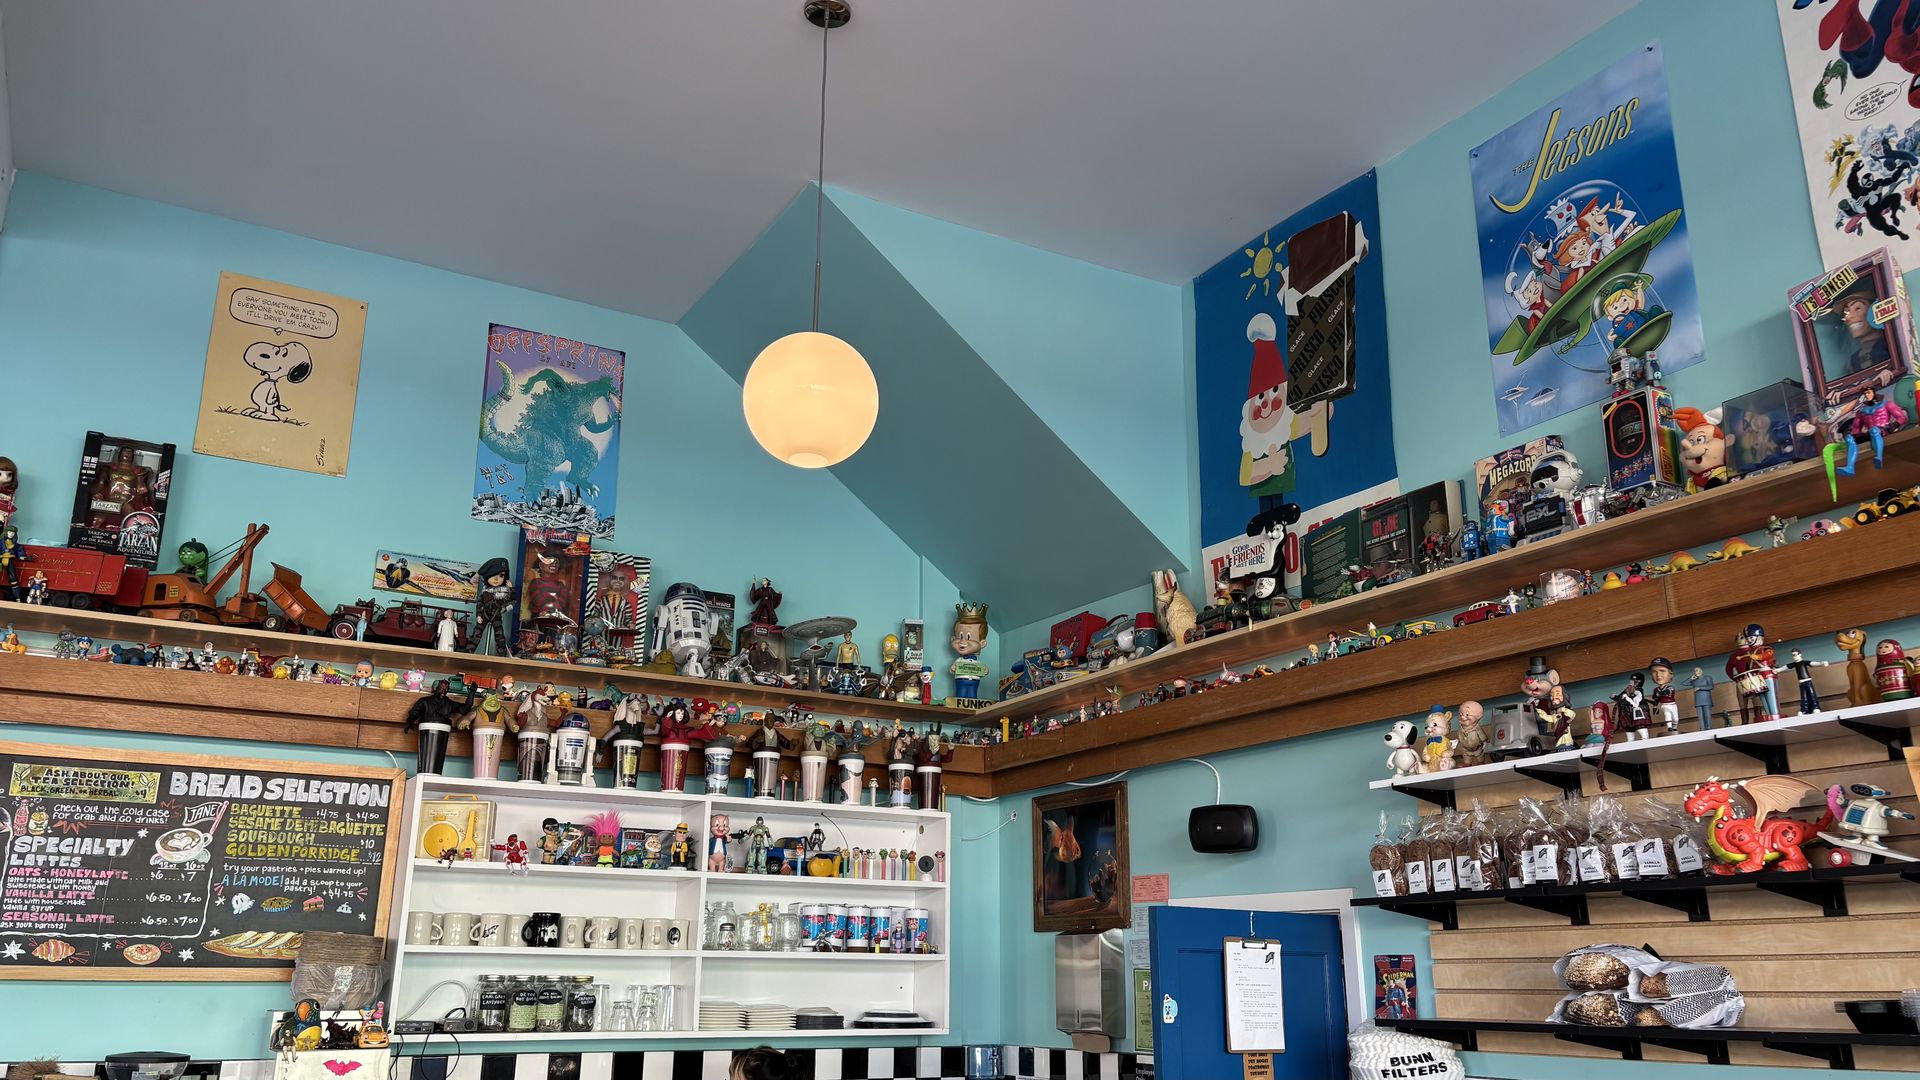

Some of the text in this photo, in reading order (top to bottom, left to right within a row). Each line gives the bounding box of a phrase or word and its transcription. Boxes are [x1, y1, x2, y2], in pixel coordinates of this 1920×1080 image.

[1489, 97, 1640, 214] THE Jetsons
[1811, 267, 1854, 307] ERNEST!
[238, 301, 272, 313] EVERYONE
[262, 299, 300, 312] SOMETHING
[1328, 300, 1345, 323] GLACE
[264, 314, 282, 323] DRIVE
[1290, 331, 1306, 353] GLACE
[1289, 329, 1325, 380] FRISCO
[1307, 357, 1324, 378] GLACE
[95, 502, 119, 510] TARZAN
[120, 532, 158, 552] TARZAN
[1232, 544, 1250, 555] GOOD
[1233, 543, 1265, 566] FRIENDS
[1249, 553, 1265, 566] HERE
[72, 771, 108, 779] ABOUT
[31, 777, 135, 789] TEA SELECTION!
[170, 772, 390, 807] BREAD SELECTION
[89, 789, 119, 797] HERBAL
[189, 804, 218, 823] JANE
[230, 803, 302, 819] BAGUETTE
[229, 817, 284, 831] SESAME
[319, 820, 386, 836] BAGUETTE
[227, 830, 316, 845] SOURDOUGH
[14, 836, 135, 857] SPECIALTY
[226, 843, 290, 858] GOLDEN
[292, 847, 360, 862] PORRIDGE
[10, 854, 82, 868] LATTES
[9, 868, 41, 877] OATS
[241, 866, 260, 874] your
[262, 865, 298, 875] pastries
[305, 866, 322, 875] pies
[233, 876, 247, 887] LA
[310, 880, 335, 888] scoop
[6, 890, 54, 899] VANILLA
[58, 891, 96, 900] LATTE
[2, 912, 73, 922] SEASONAL
[76, 914, 115, 924] LATTE
[1390, 1052, 1434, 1067] BUNN
[1381, 1062, 1448, 1079] FILTERS
